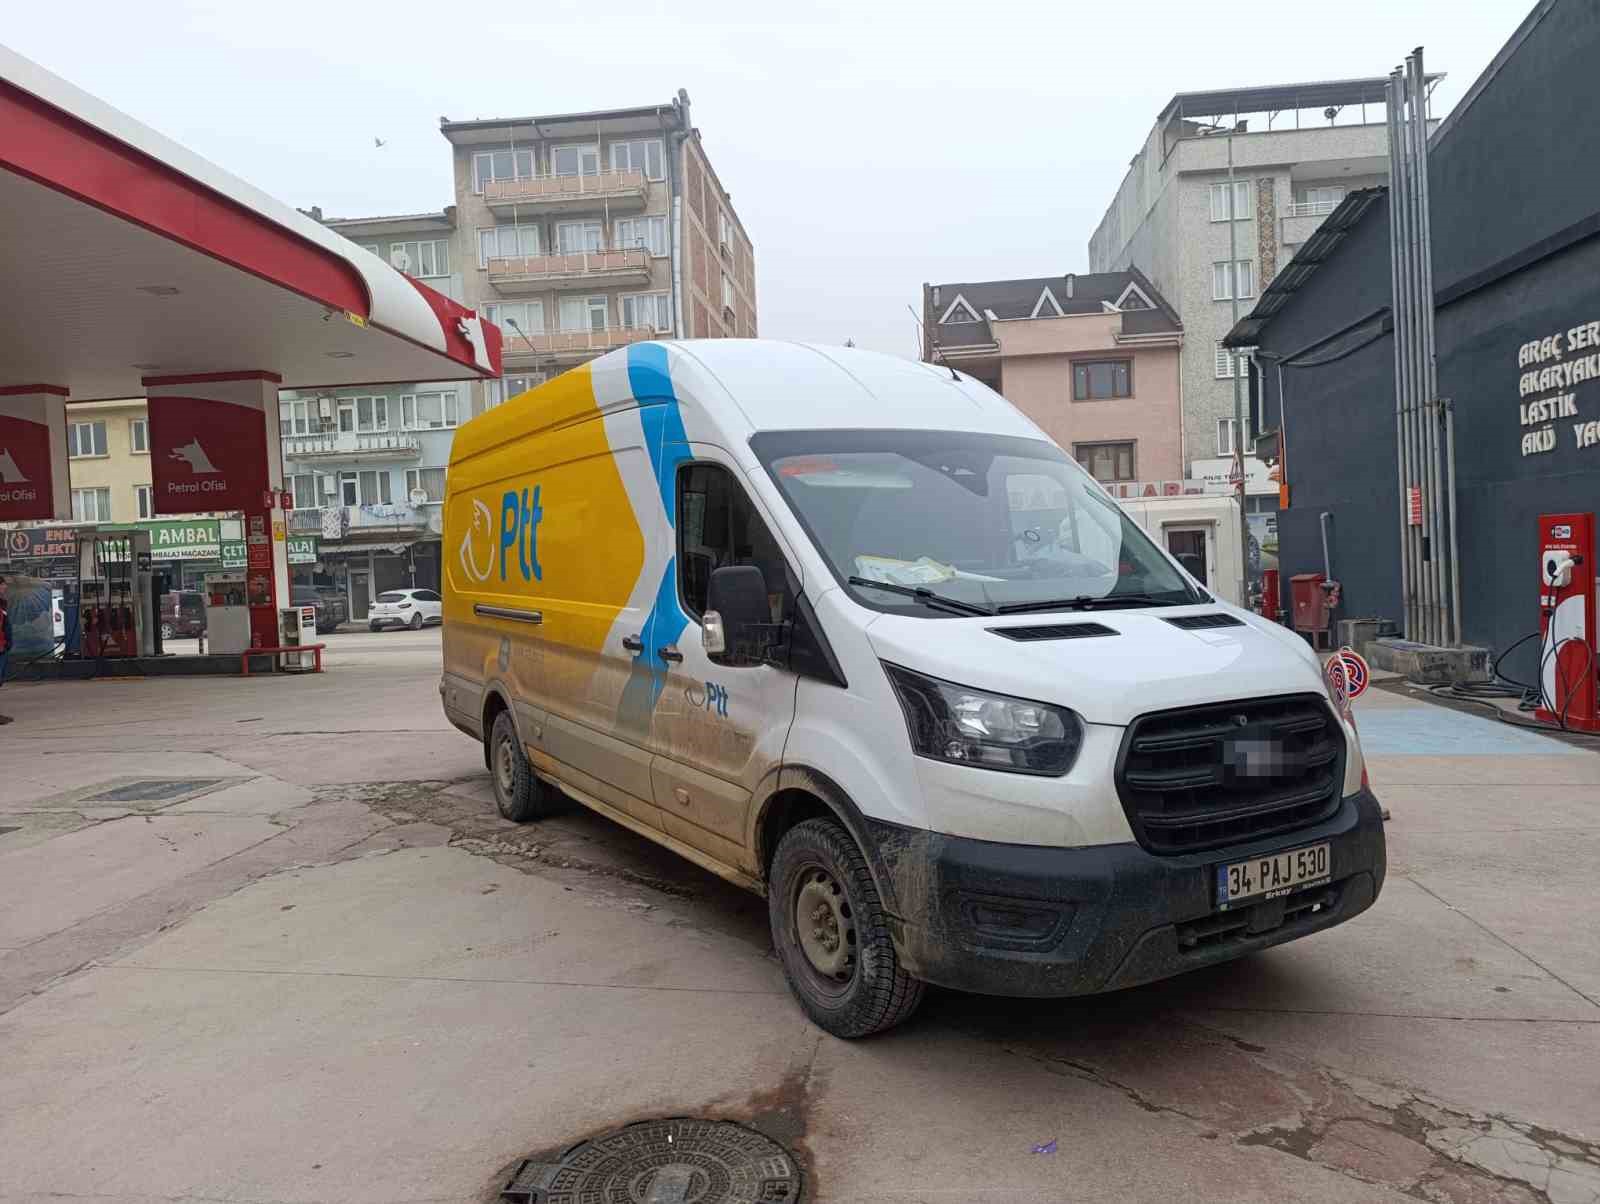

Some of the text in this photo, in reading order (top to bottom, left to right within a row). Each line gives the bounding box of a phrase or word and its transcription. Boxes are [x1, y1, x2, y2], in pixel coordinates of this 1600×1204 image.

[1519, 333, 1562, 368] ARAÇ
[1520, 391, 1578, 425] LASTİK
[1522, 424, 1556, 456] AKÜ
[12, 488, 37, 501] Ofisi
[168, 479, 227, 493] Petrol Ofisi
[501, 484, 543, 582] Ptt
[706, 682, 728, 718] Ptt
[1229, 865, 1251, 895] 34
[1260, 855, 1292, 889] PAJ
[1297, 847, 1326, 879] 530
